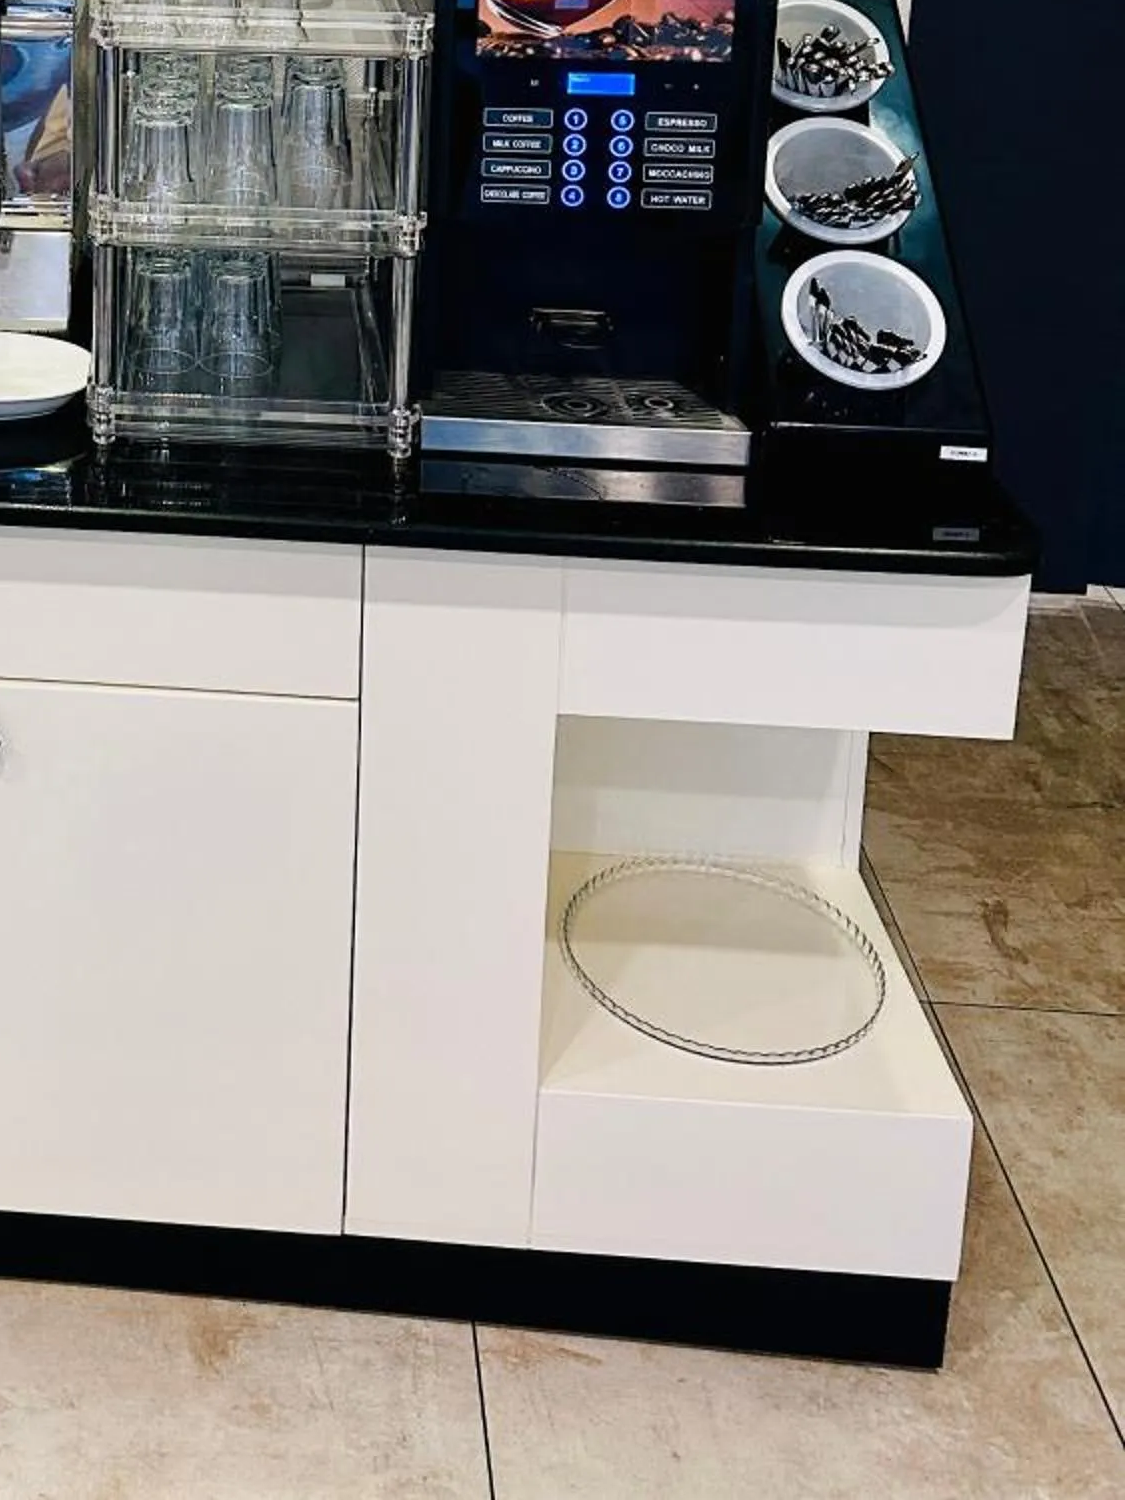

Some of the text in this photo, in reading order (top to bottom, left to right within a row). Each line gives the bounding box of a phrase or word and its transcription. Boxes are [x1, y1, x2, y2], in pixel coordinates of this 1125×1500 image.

[502, 113, 534, 123] COFFEE
[658, 117, 708, 127] ESPRESSO
[492, 139, 542, 149] MILK COFFEE
[571, 139, 580, 150] 2
[618, 141, 626, 152] 6
[650, 143, 711, 153] CHOCO MILK
[490, 165, 542, 175] CAPPUCCINO
[616, 167, 624, 177] 7
[650, 195, 707, 204] HOT WATER
